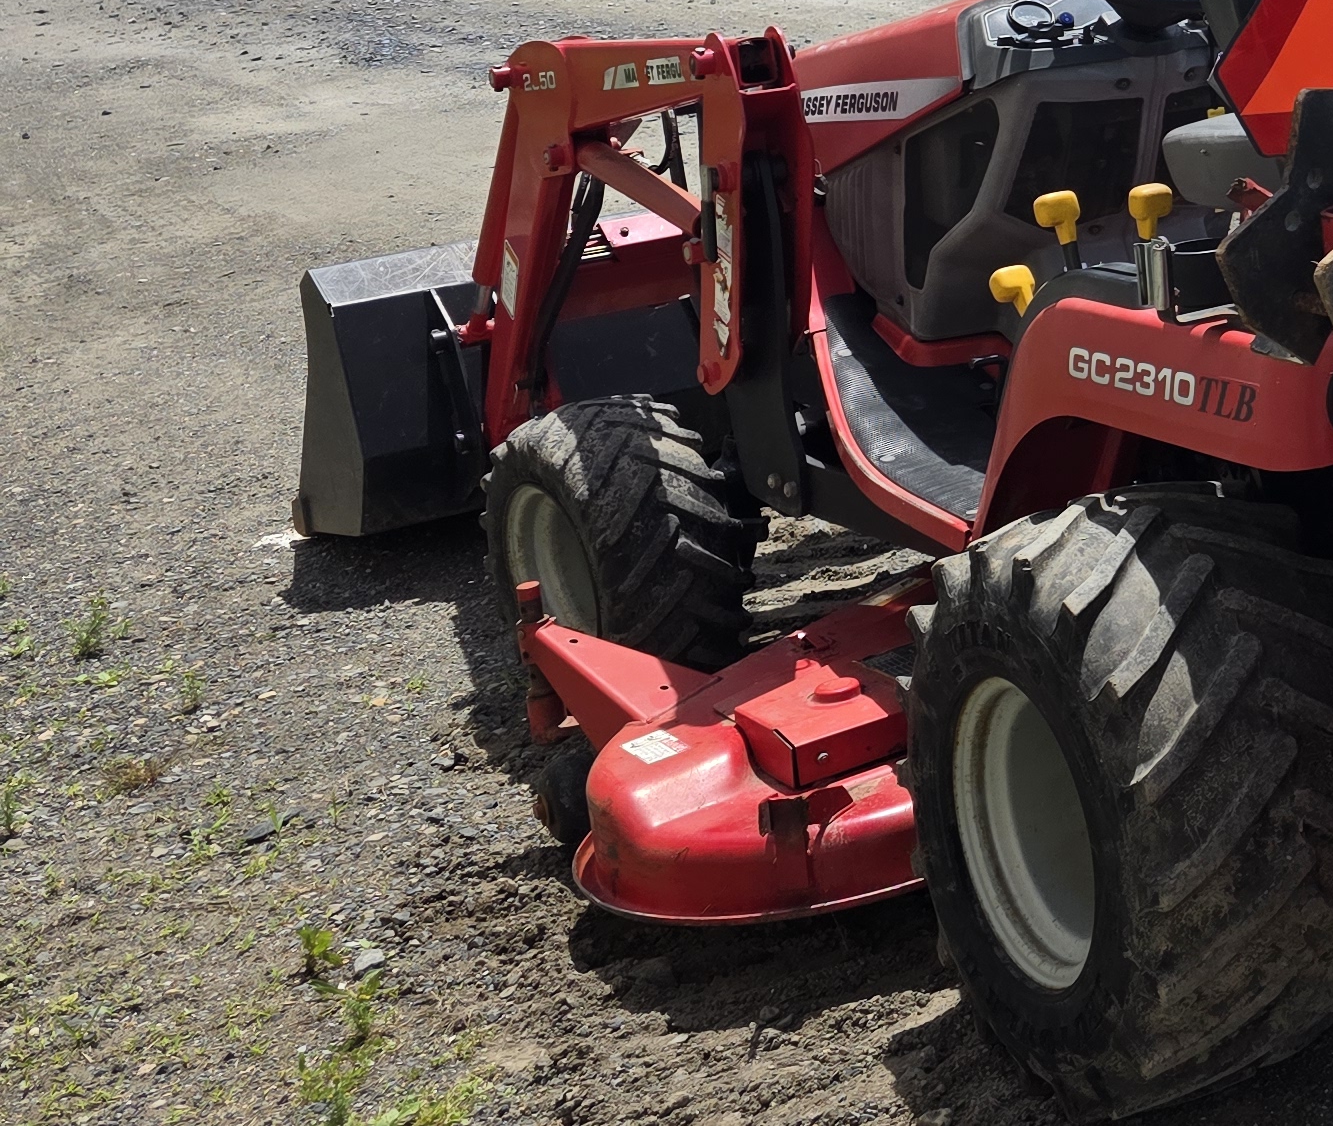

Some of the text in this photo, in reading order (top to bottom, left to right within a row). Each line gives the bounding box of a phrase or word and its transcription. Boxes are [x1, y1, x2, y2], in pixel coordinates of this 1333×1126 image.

[523, 71, 556, 91] 250
[801, 91, 898, 116] SSEY FERGUSON
[1068, 347, 1257, 423] GC2310 TLB
